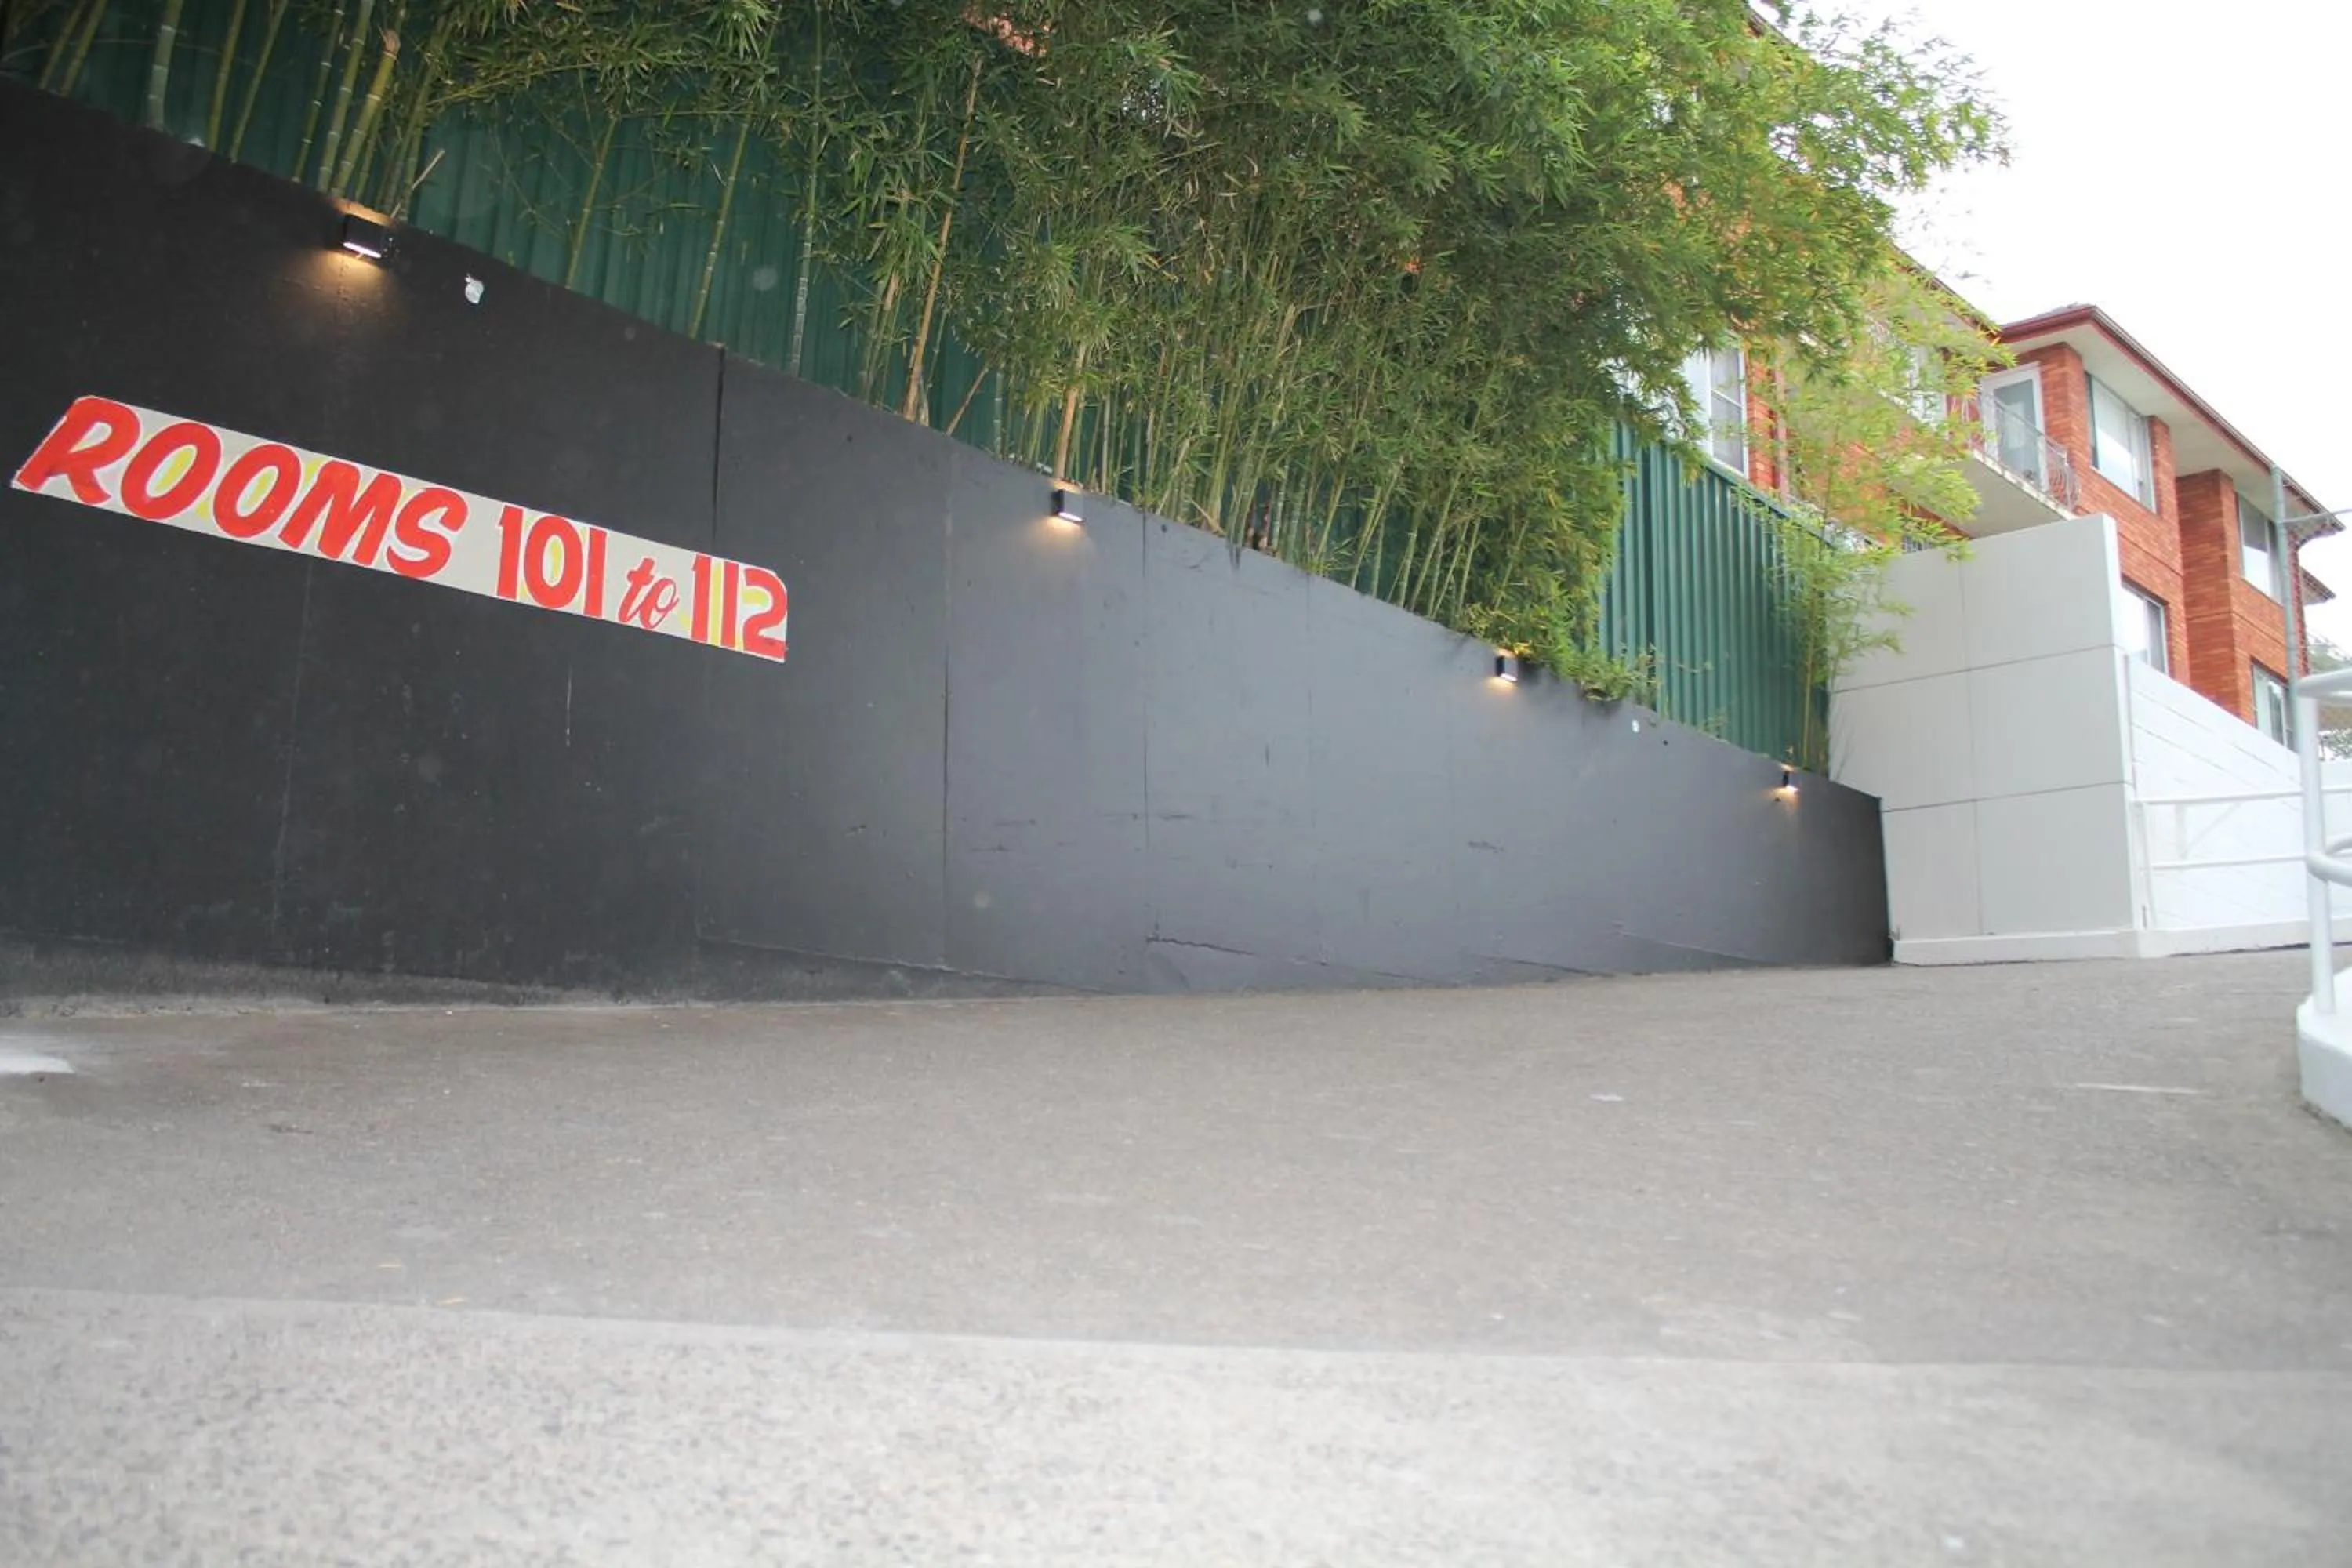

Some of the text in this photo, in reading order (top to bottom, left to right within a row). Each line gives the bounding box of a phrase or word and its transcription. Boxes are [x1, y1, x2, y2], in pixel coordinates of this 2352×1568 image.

[16, 397, 789, 659] ROOMS 101 to 112
